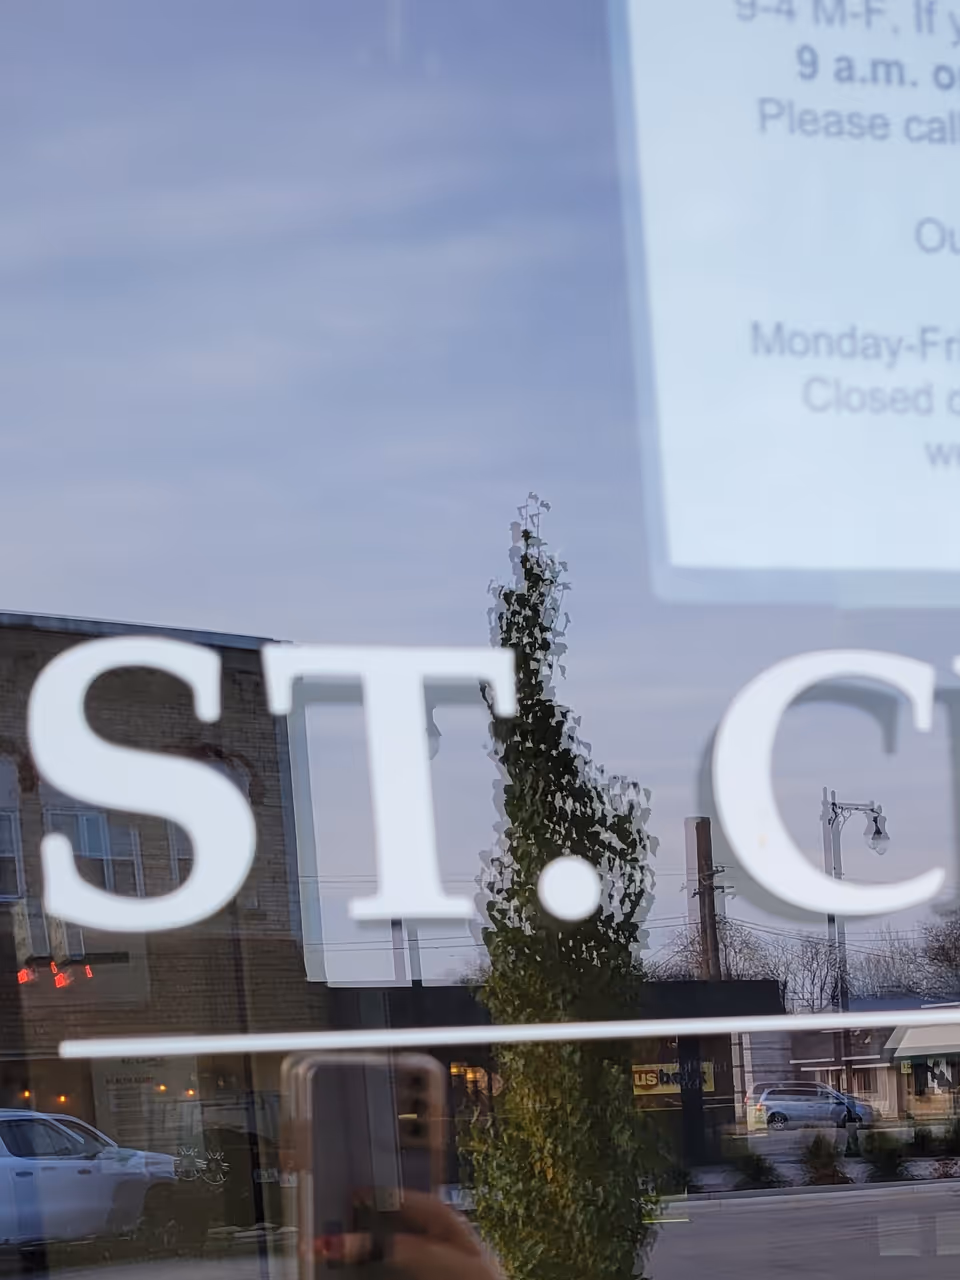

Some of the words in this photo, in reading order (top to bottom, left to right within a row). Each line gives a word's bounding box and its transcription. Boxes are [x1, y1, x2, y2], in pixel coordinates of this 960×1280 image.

[811, 0, 901, 36] M-F.
[914, 0, 938, 35] If
[796, 44, 818, 81] 9
[833, 55, 918, 89] a.m.
[757, 97, 890, 142] Please
[801, 376, 933, 418] Closed
[27, 636, 602, 932] ST.
